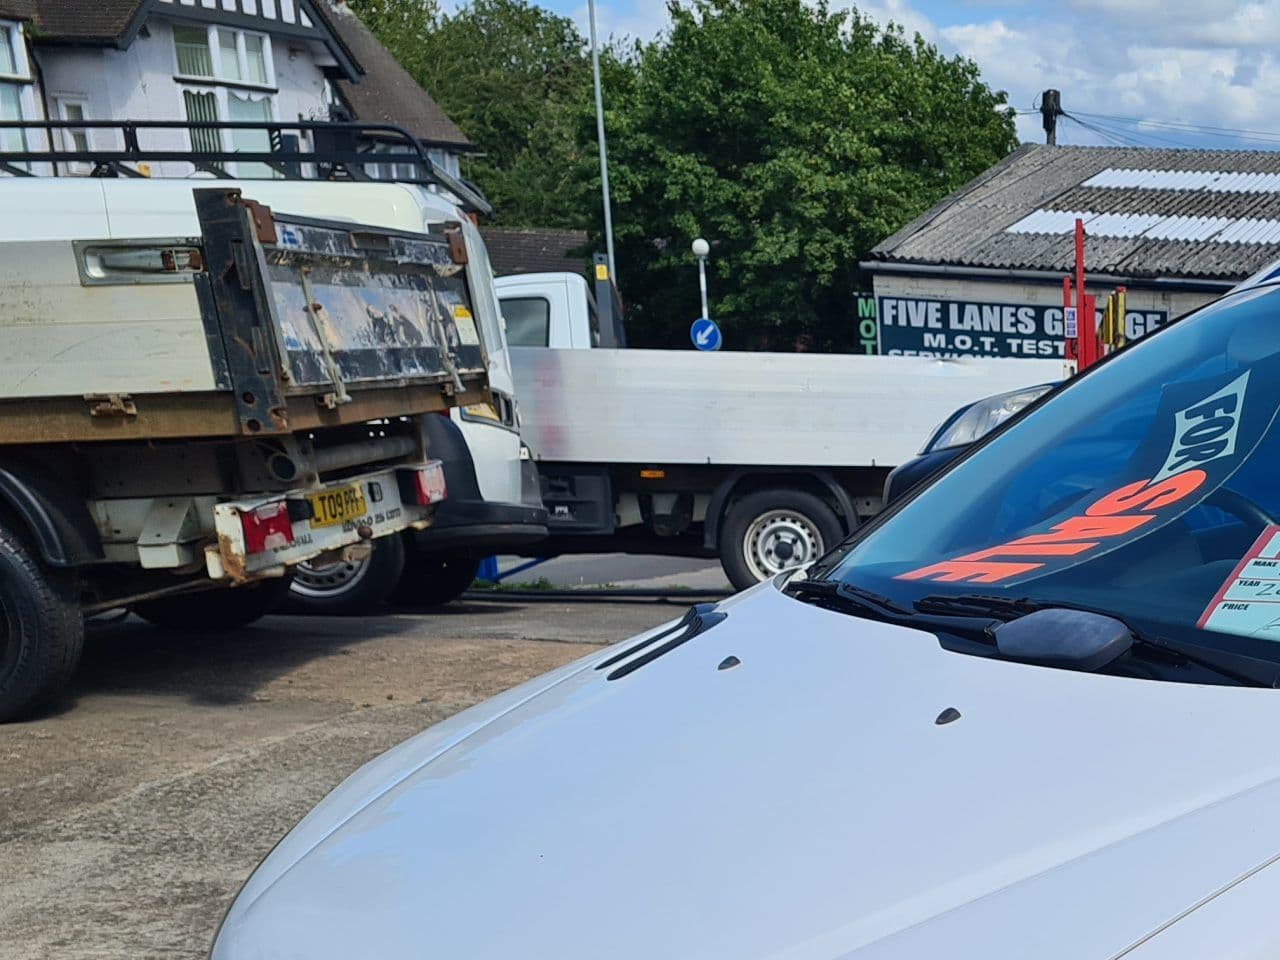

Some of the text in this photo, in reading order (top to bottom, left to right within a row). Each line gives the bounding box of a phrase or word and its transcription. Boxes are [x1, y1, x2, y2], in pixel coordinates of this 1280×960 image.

[857, 298, 876, 355] MOT
[882, 298, 942, 329] FIVE
[948, 302, 1037, 335] LANES
[1043, 308, 1161, 340] GGE
[923, 333, 999, 352] M.O.T.
[1168, 393, 1237, 471] FOR
[893, 469, 1207, 583] SALE
[1238, 579, 1261, 587] YEAR
[1221, 602, 1250, 611] PRICE
